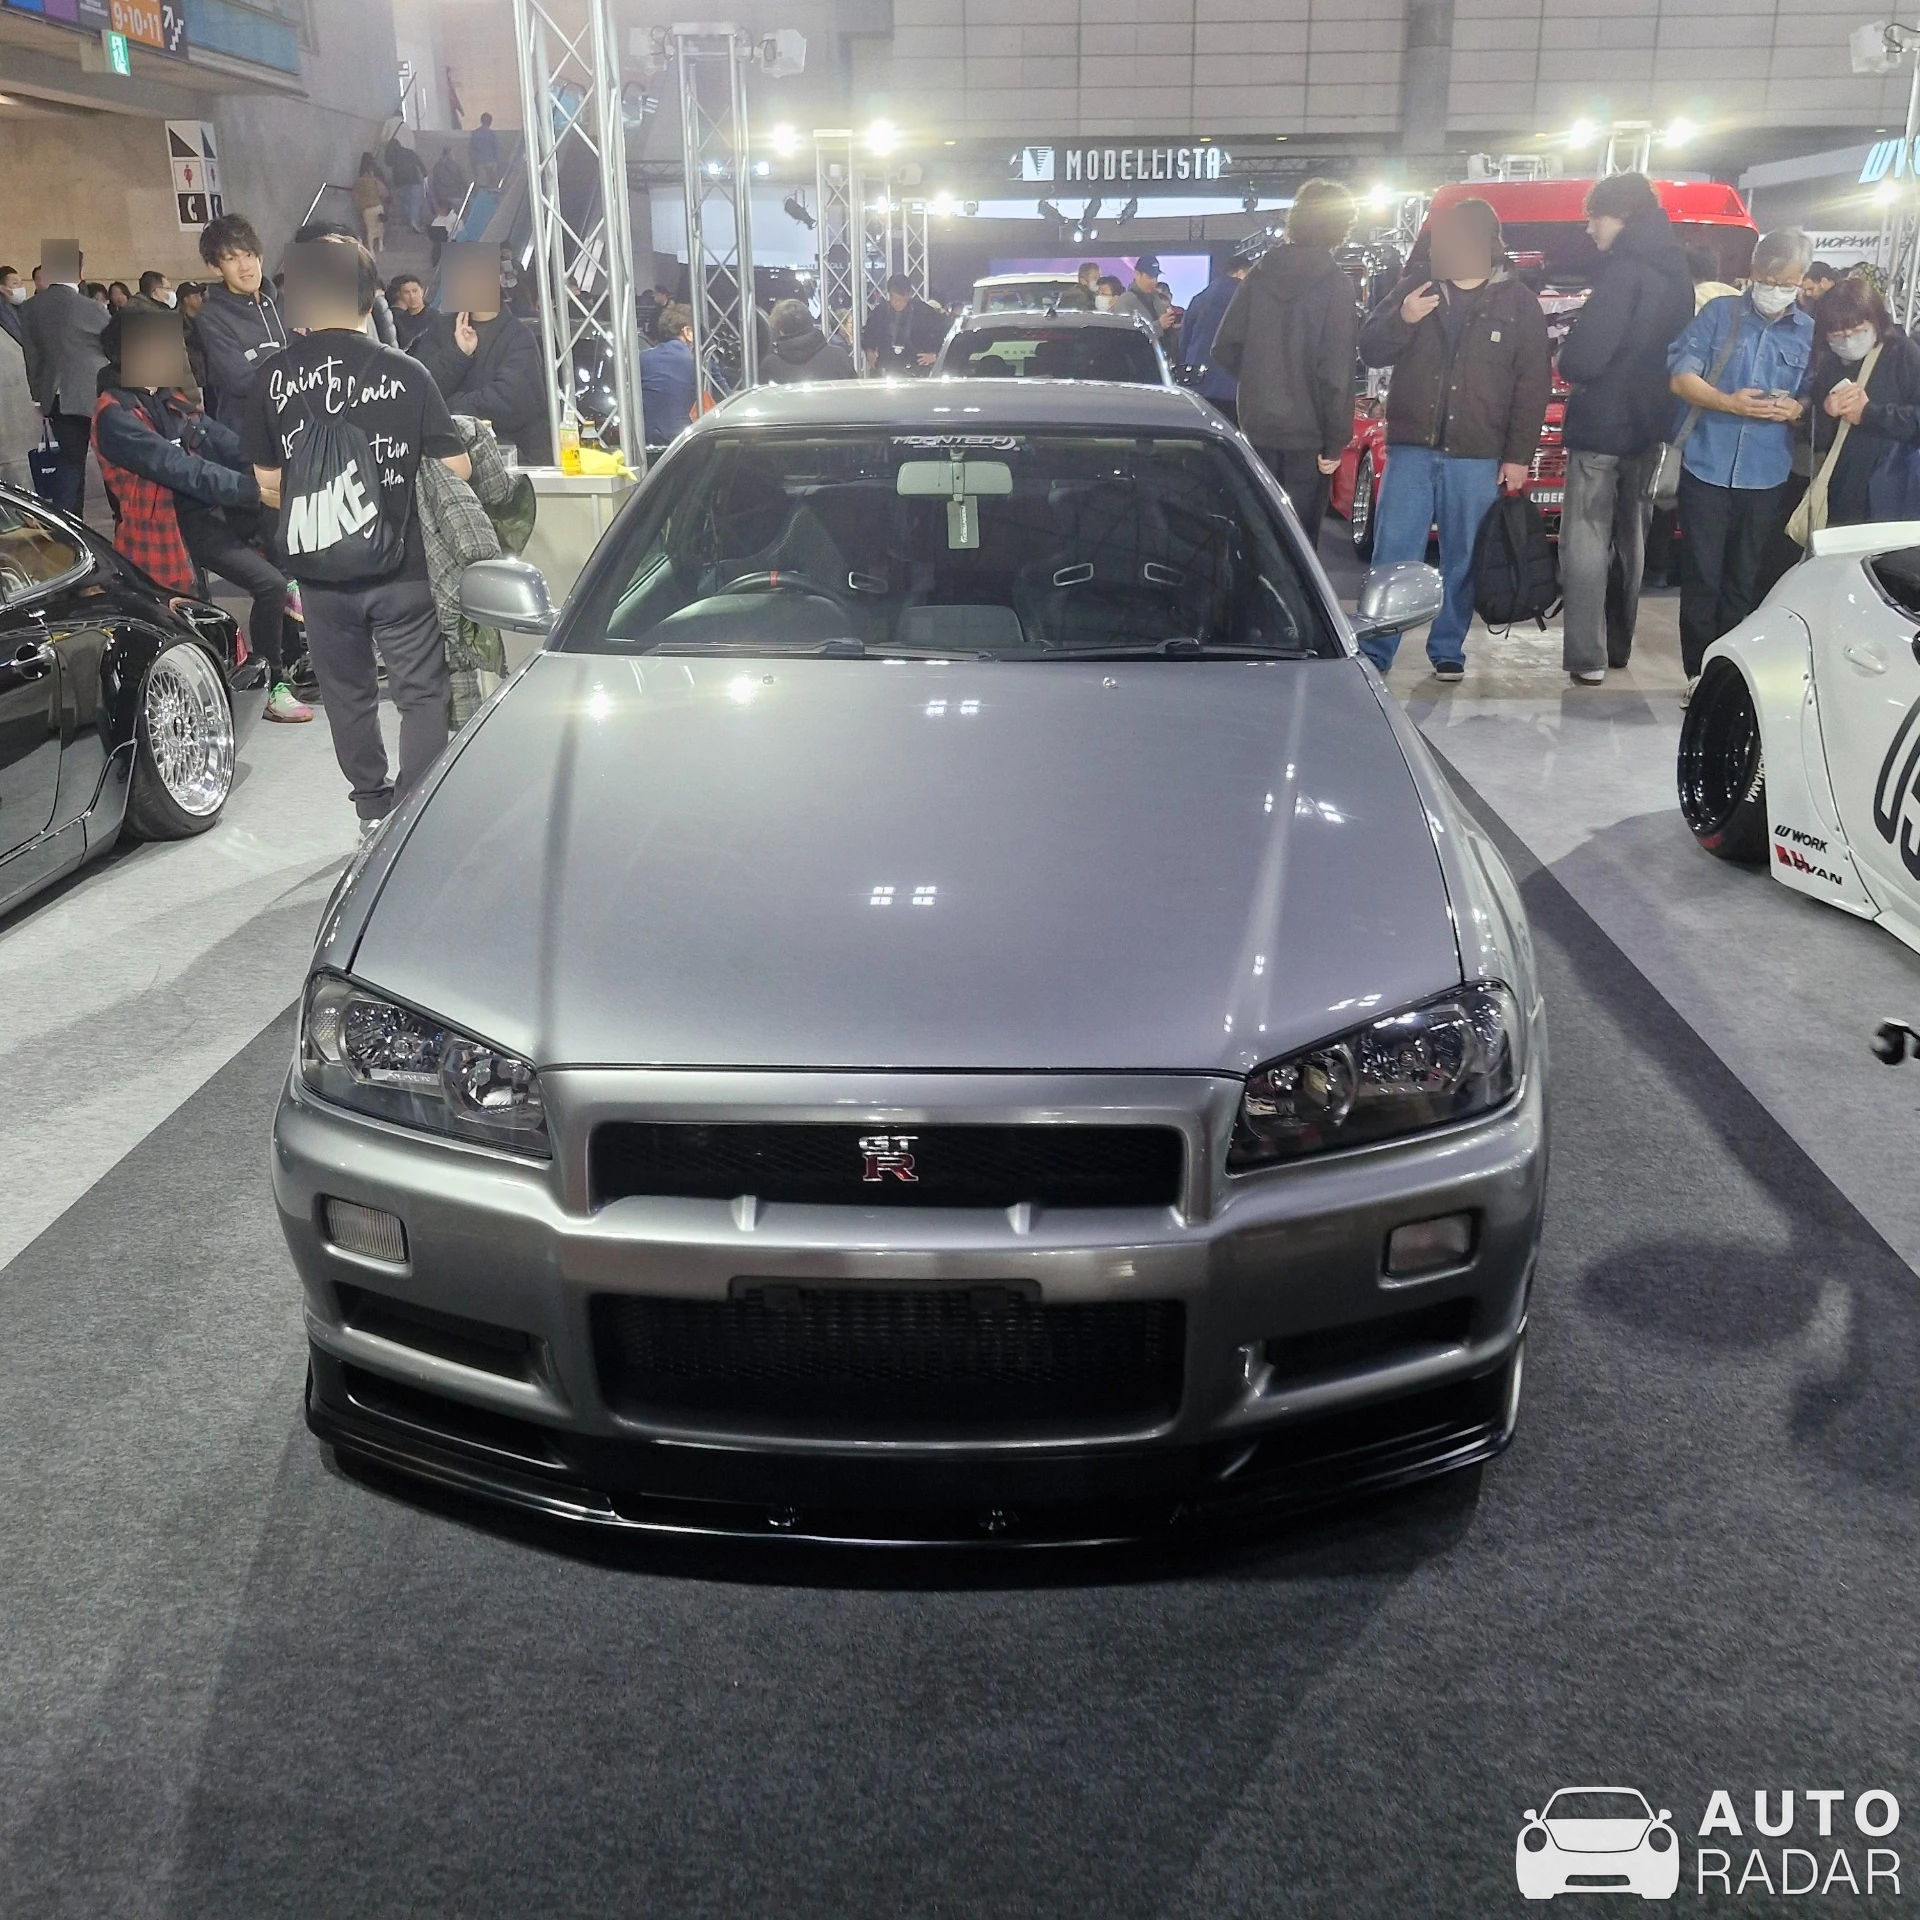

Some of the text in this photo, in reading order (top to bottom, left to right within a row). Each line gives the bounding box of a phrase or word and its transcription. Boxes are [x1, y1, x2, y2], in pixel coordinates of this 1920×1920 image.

[1066, 147, 1220, 181] MODELLISTA
[270, 355, 343, 414] Saint
[287, 459, 378, 555] NIKE
[1530, 492, 1565, 503] LIBER
[1744, 754, 1765, 803] OHAMA
[1791, 829, 1828, 854] WORK
[858, 1135, 919, 1151] GT
[862, 1151, 919, 1182] R
